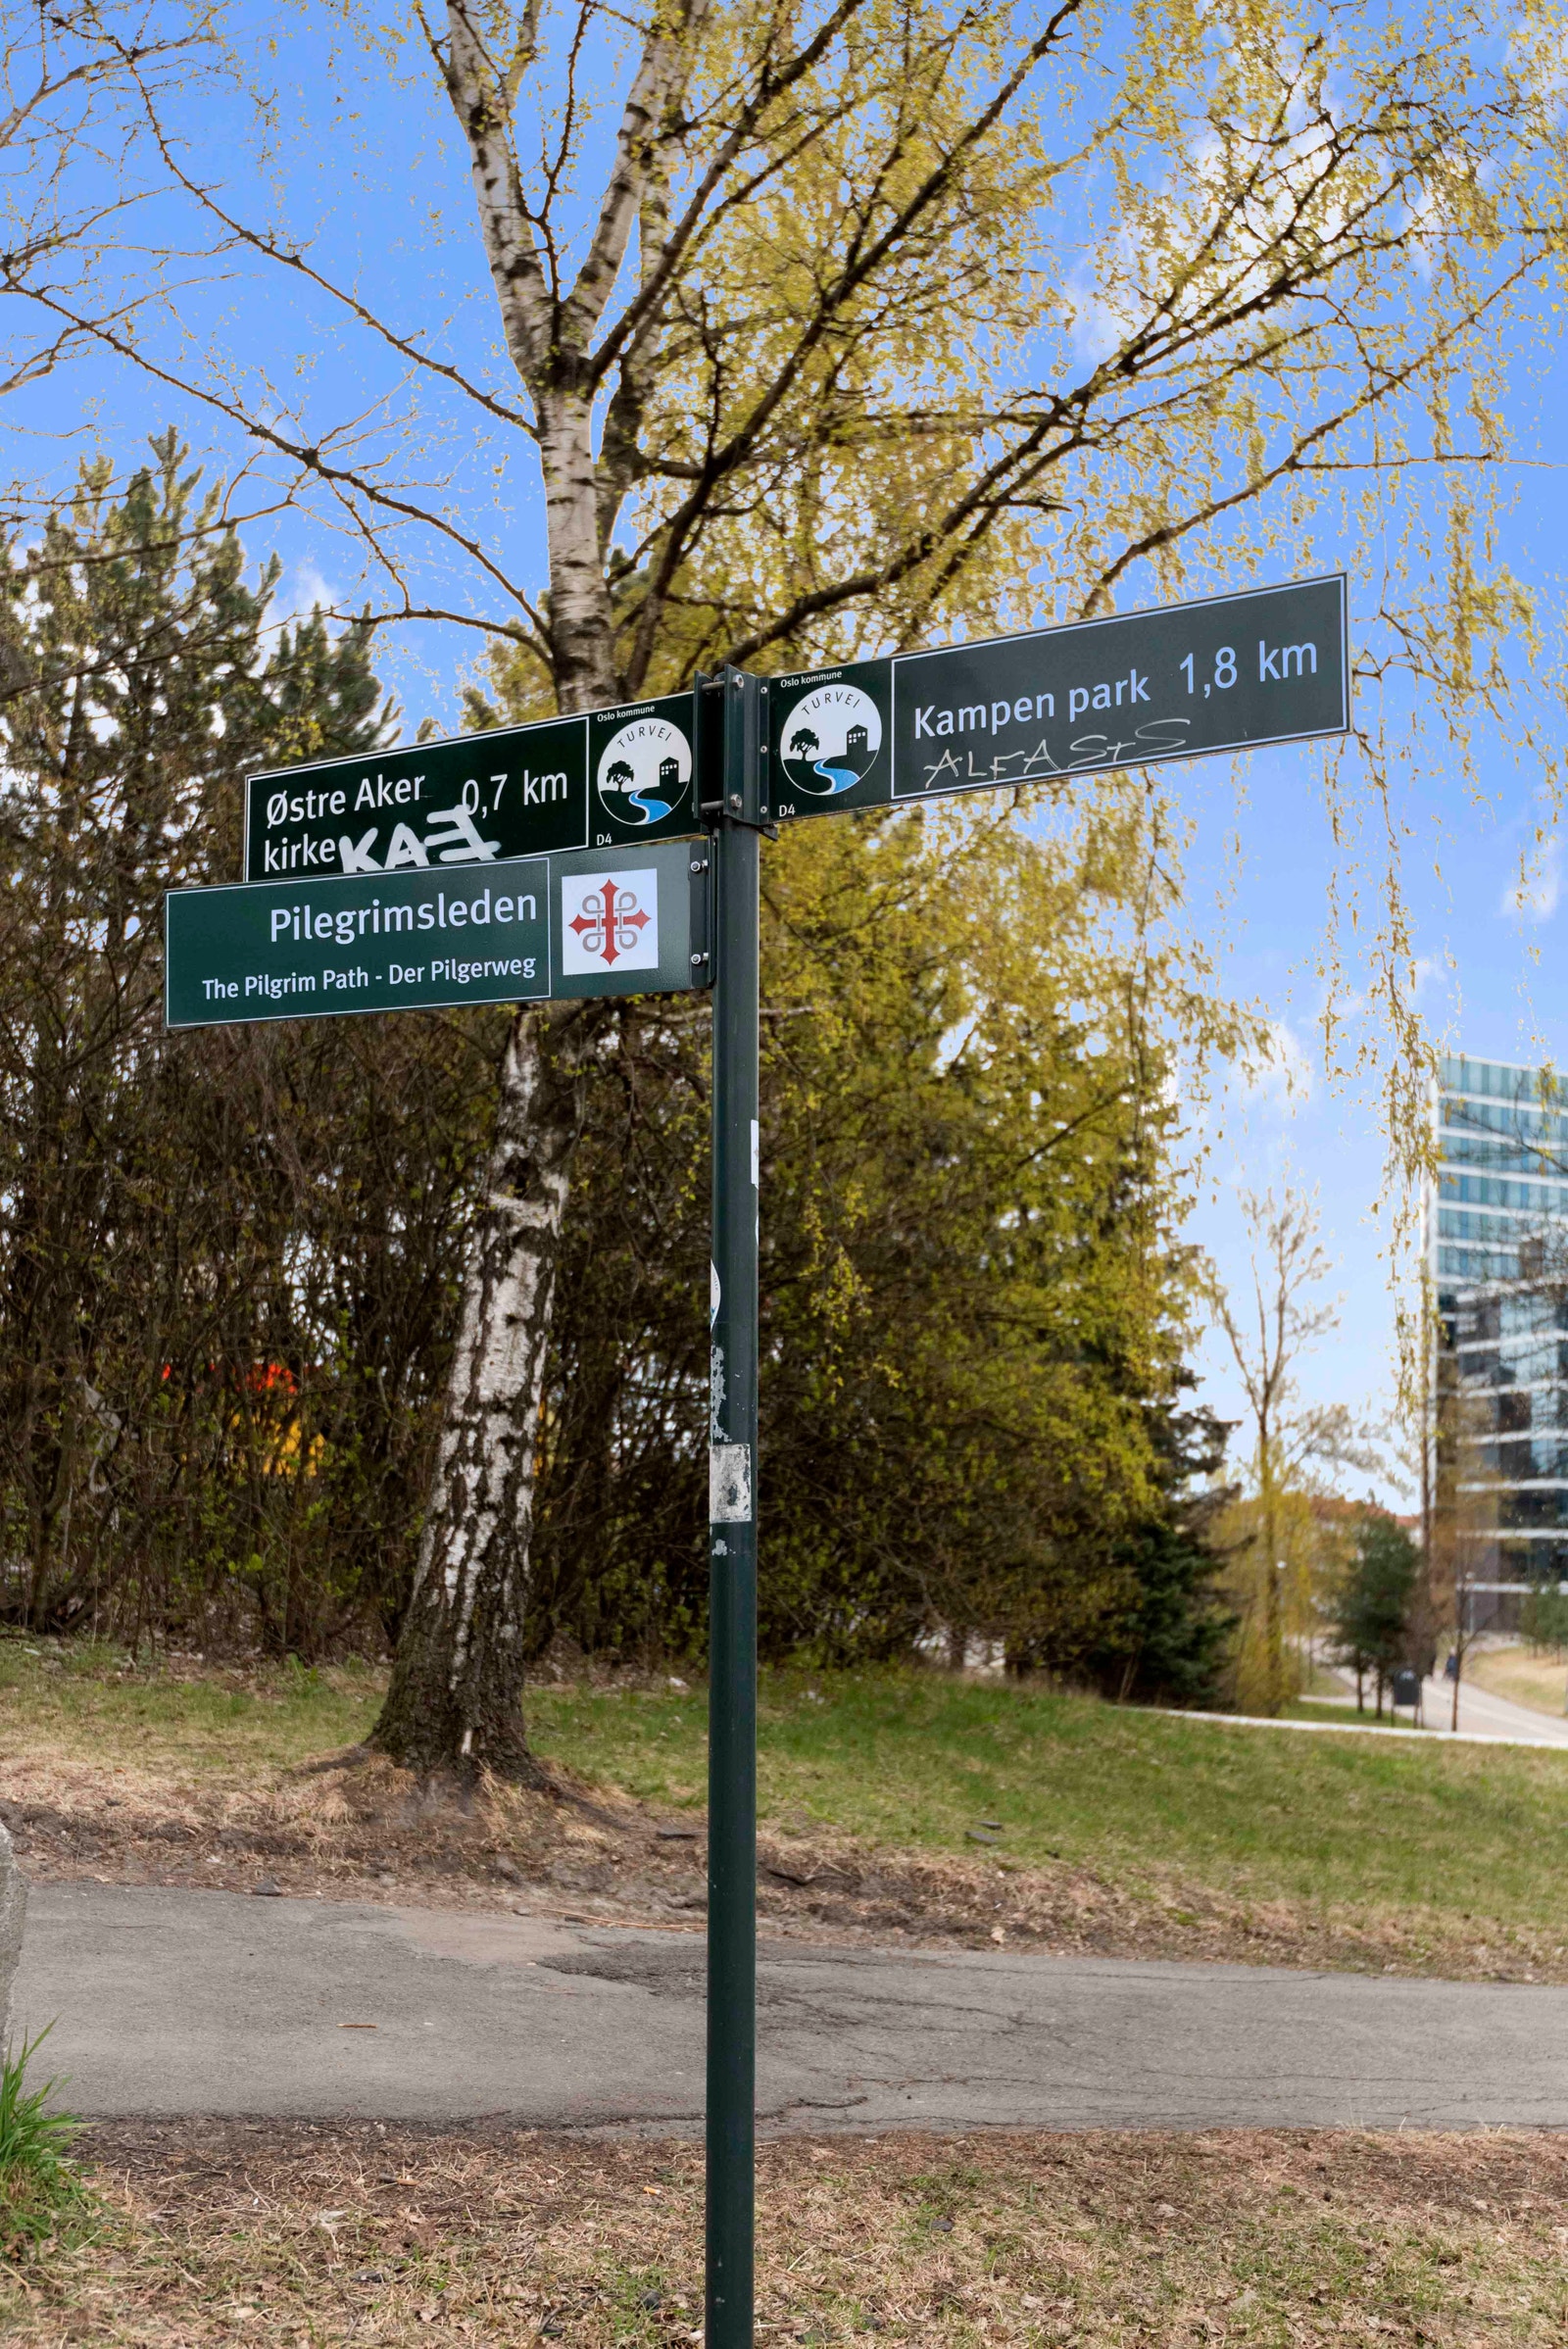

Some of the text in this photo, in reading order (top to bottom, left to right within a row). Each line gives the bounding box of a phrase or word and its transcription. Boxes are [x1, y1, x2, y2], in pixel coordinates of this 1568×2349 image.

[780, 670, 843, 689] Oslo kommune
[914, 640, 1318, 739] Kampen park 1,8 km
[597, 705, 656, 723] Oslo kommune
[801, 691, 860, 715] TURVEI
[617, 724, 672, 748] TURVEI
[266, 769, 568, 829] Østre Aker 0,7 km
[778, 804, 796, 817] D4
[596, 833, 612, 847] D4
[264, 833, 336, 872] kirke
[270, 888, 537, 945] Pilegrimsleden
[202, 979, 239, 1000] The
[245, 971, 316, 999] Pilgrim
[322, 966, 369, 991] Path
[389, 963, 425, 985] Der
[431, 956, 537, 984] Pilgerweg
